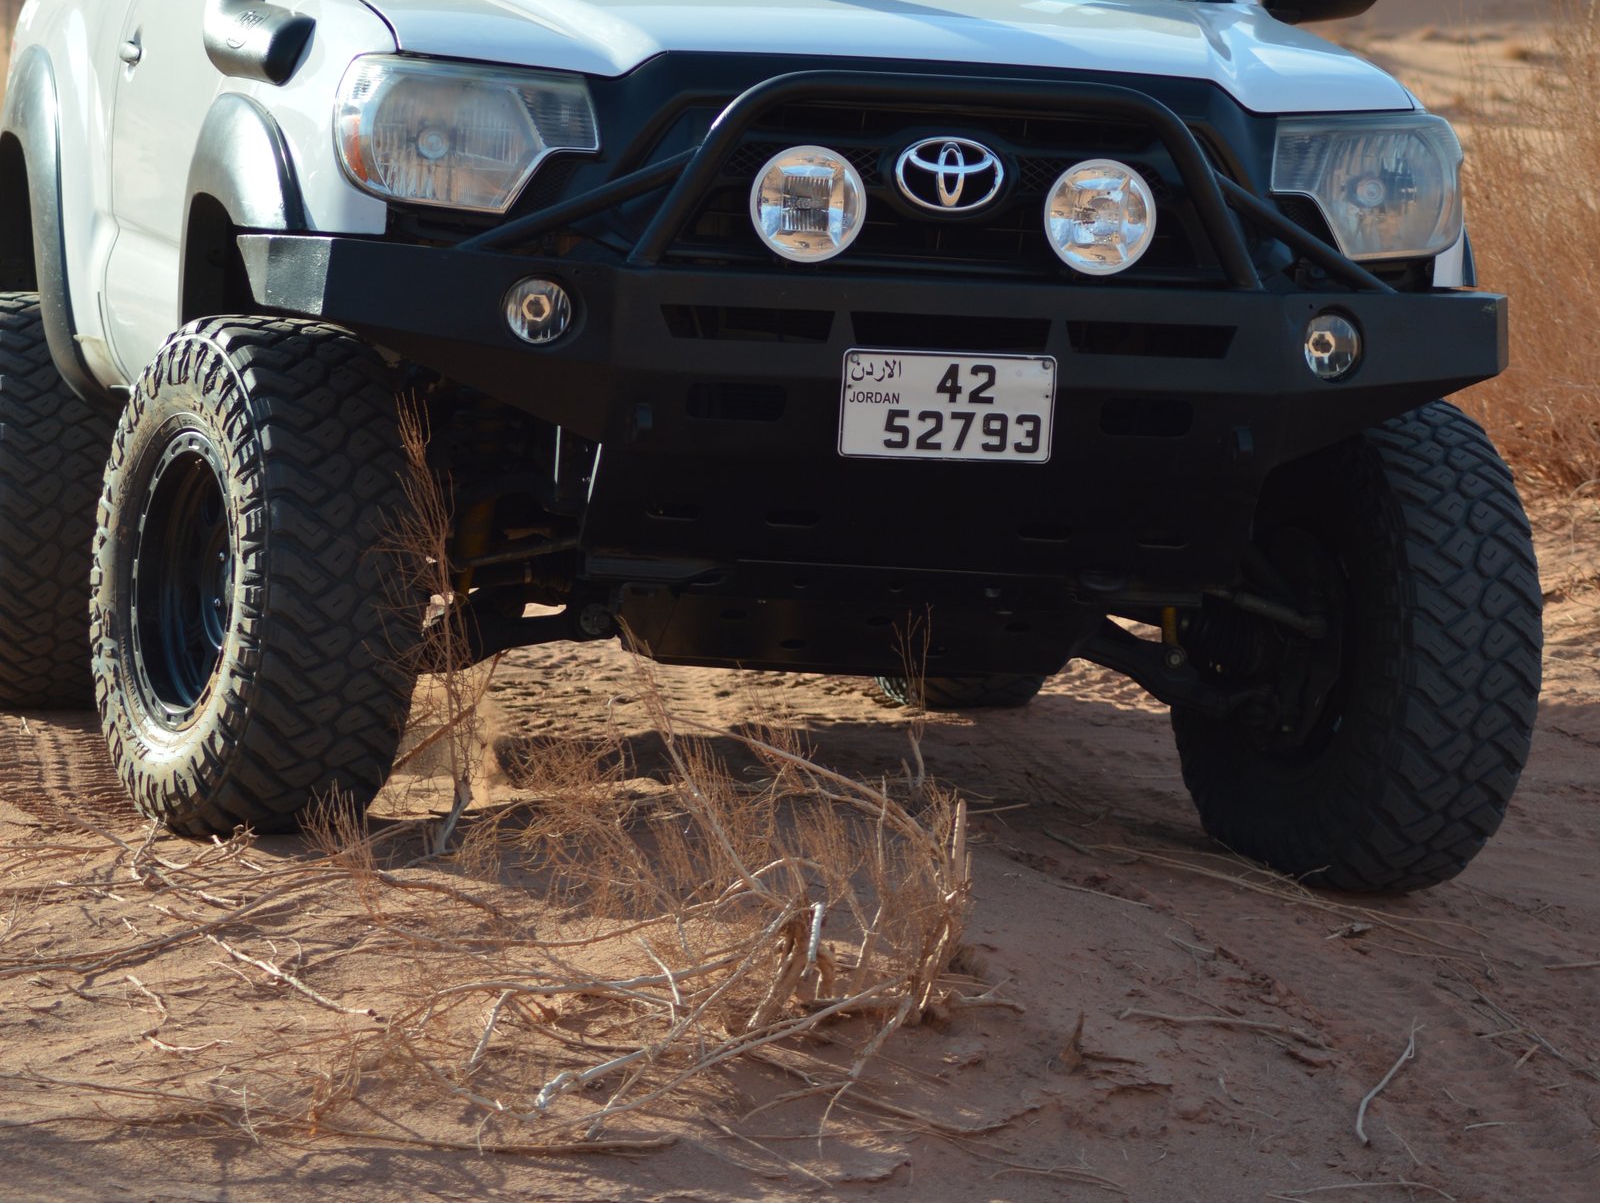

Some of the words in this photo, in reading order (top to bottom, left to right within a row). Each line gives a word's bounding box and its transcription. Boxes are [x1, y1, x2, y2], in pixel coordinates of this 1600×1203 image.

[849, 391, 900, 405] JORDAN
[936, 363, 996, 404] 42
[883, 408, 1041, 454] 52793
